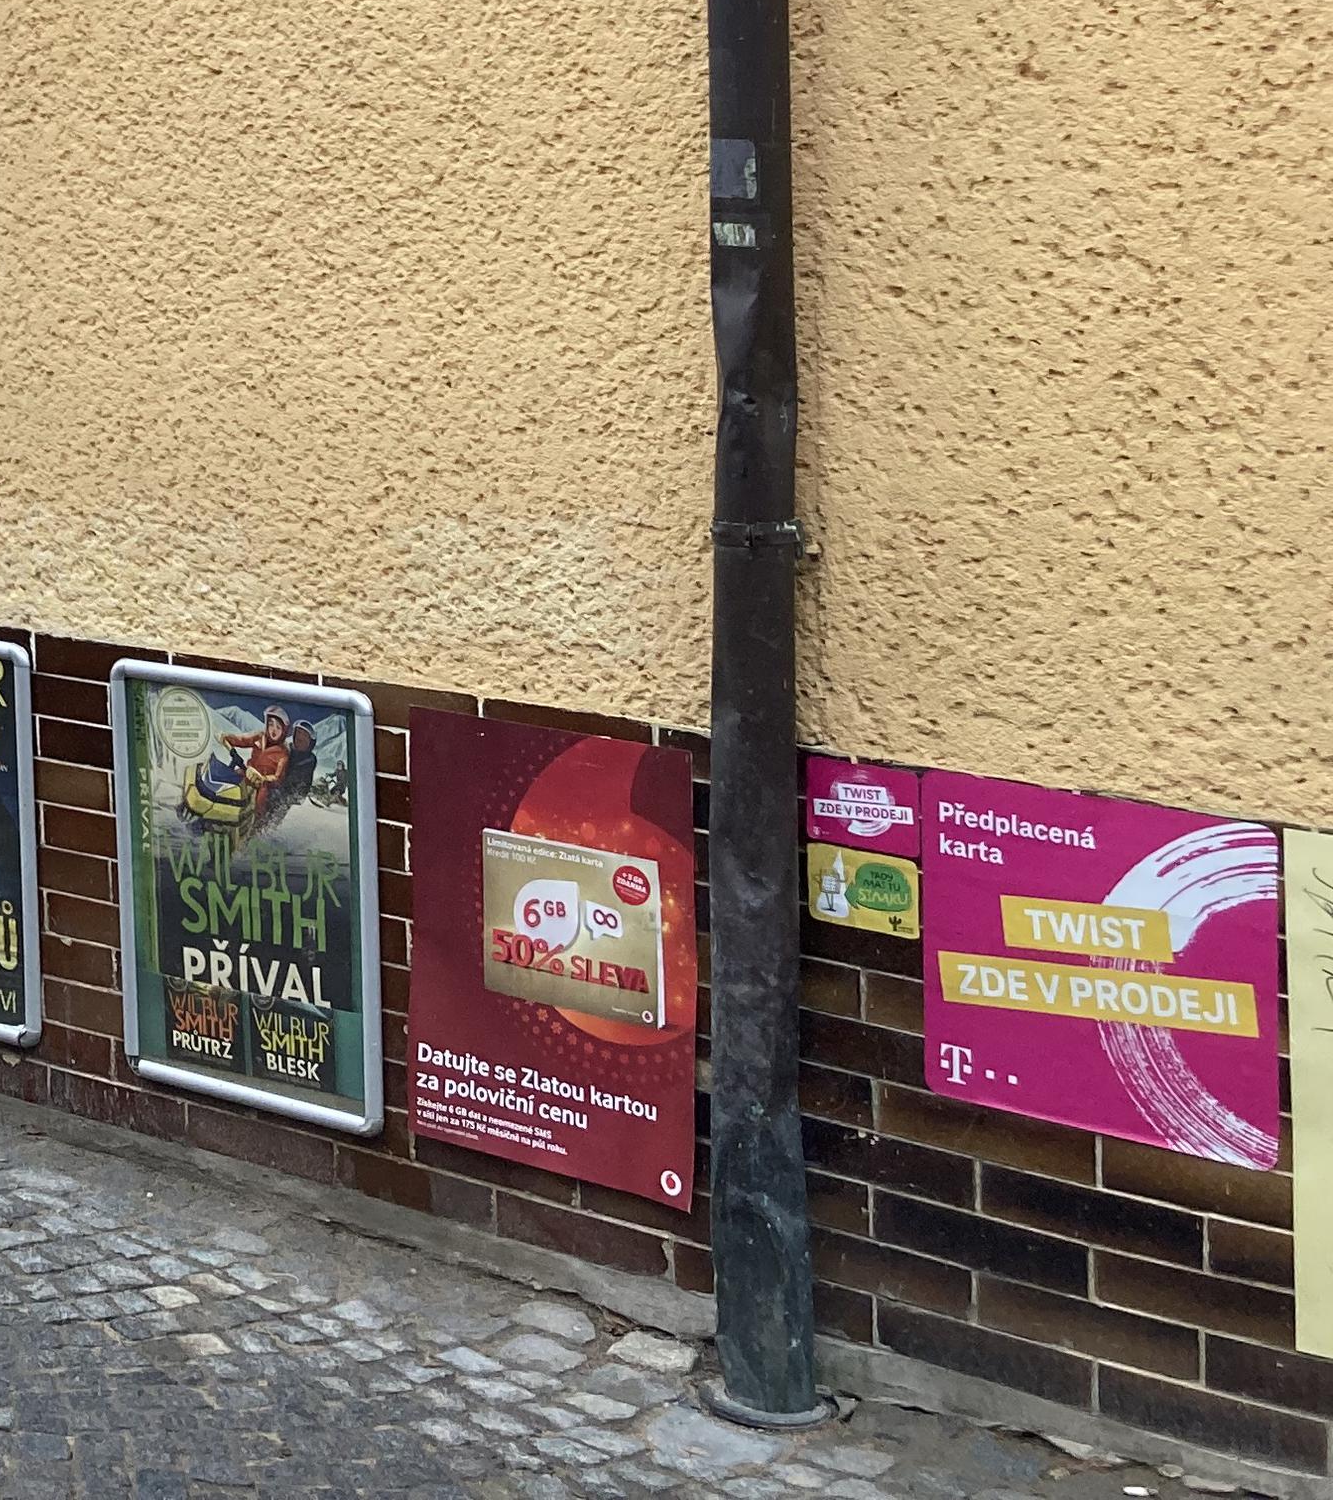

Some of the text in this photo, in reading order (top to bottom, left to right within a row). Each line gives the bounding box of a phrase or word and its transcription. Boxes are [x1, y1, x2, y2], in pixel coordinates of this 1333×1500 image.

[819, 802, 909, 821] ZDE V PRODEJI
[842, 786, 882, 801] TWIST
[938, 802, 1097, 850] Předplacená
[486, 836, 532, 855] Limitovaná
[559, 849, 580, 864] Zlatá
[581, 855, 604, 869] karta
[938, 833, 1005, 866] karta
[166, 831, 342, 908] WILBUR
[180, 876, 327, 953] SMITH
[523, 898, 567, 928] 6 GB
[1024, 907, 1145, 951] TWIST
[182, 939, 332, 1009] PŘÍVAL
[491, 928, 651, 995] 50% SLEVA
[170, 995, 239, 1026] WILBUR
[957, 963, 1238, 1026] ZDE V PRODEJI
[173, 1009, 234, 1041] SMITH
[251, 1008, 331, 1047] WILBUR
[171, 1028, 234, 1060] PRŮTRŽ
[259, 1029, 325, 1064] SMITH
[265, 1051, 321, 1082] BLESK
[416, 1042, 658, 1122] Datujte se Zlatou kartou
[416, 1072, 589, 1130] za poloviční cenu
